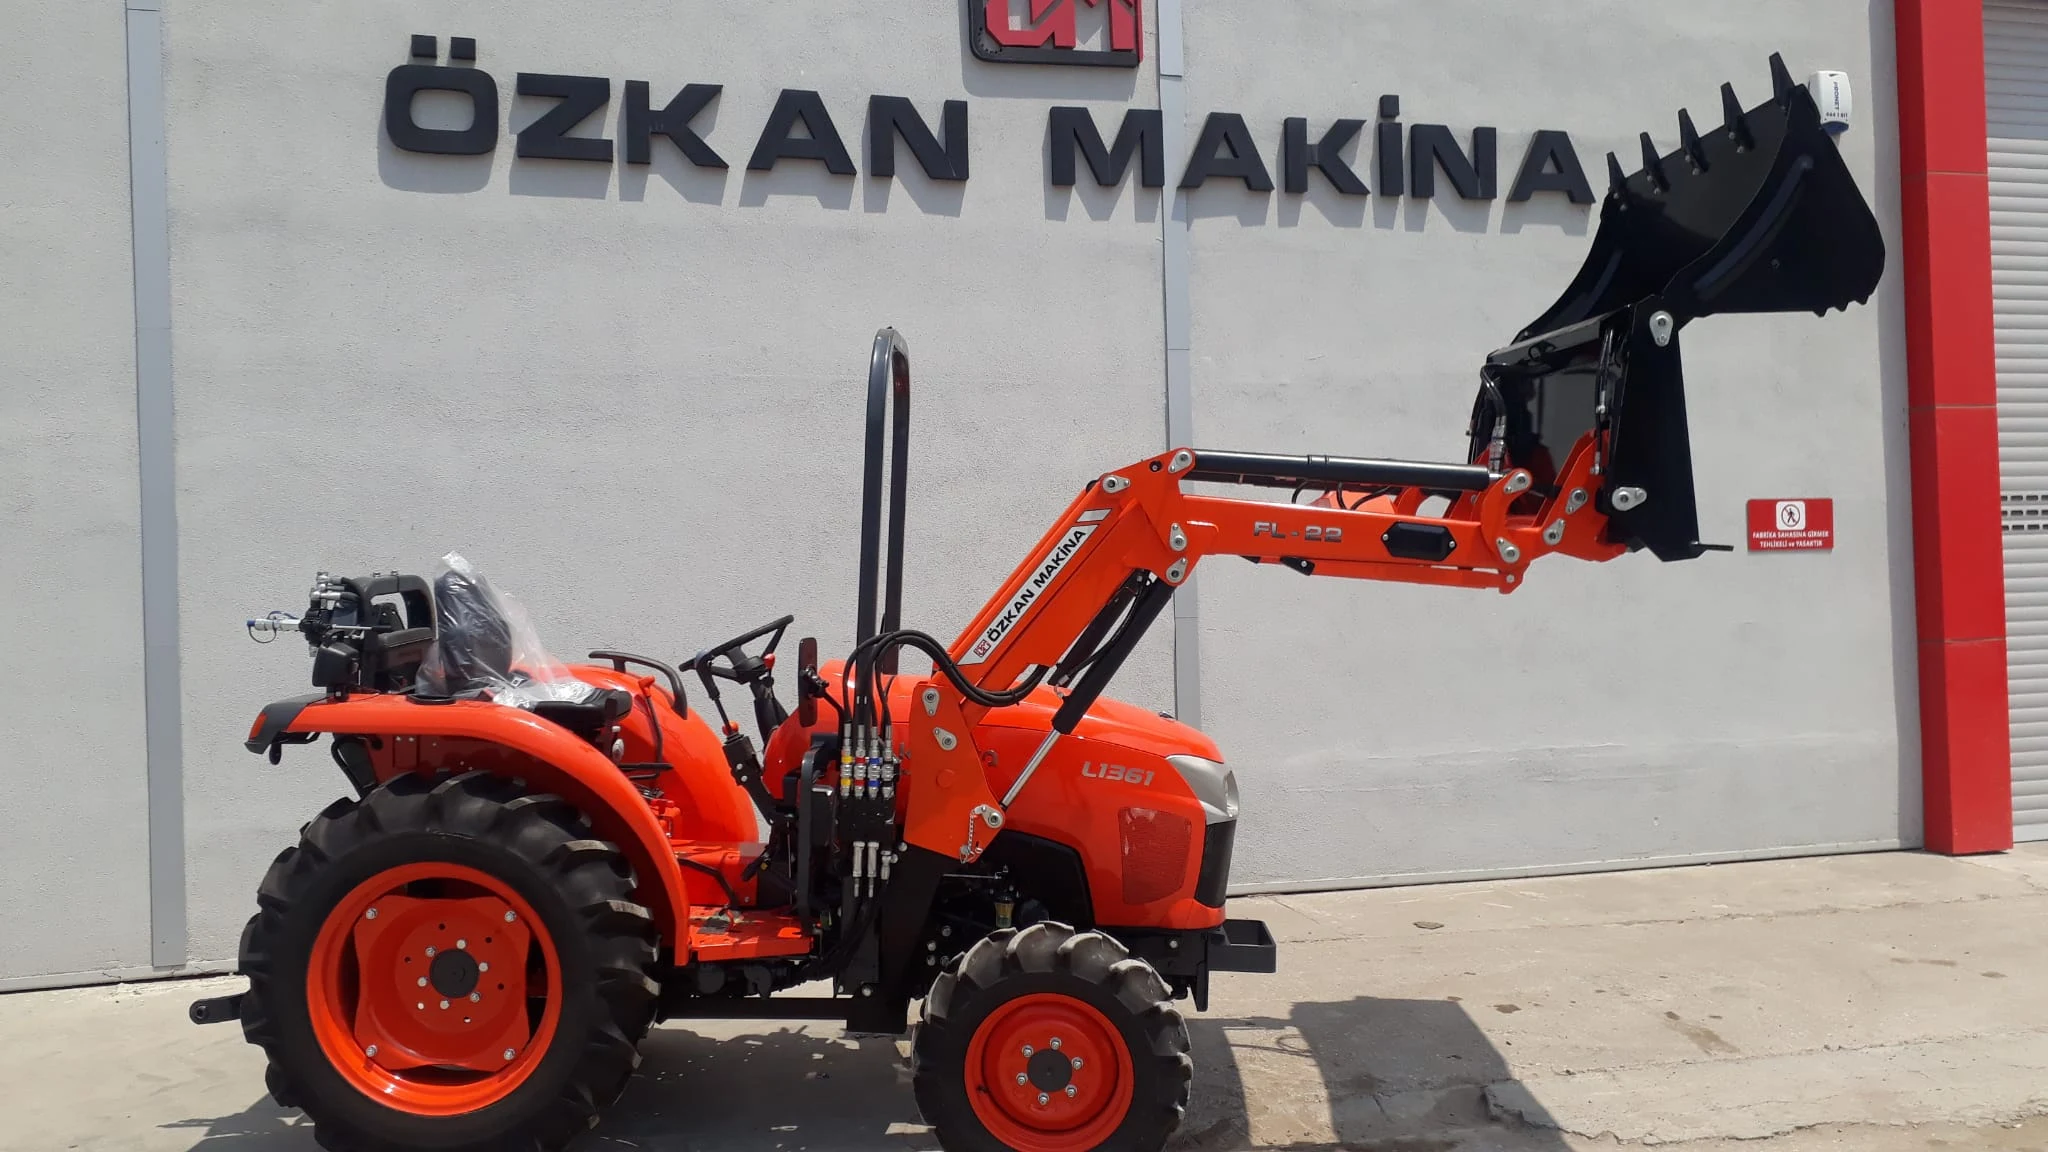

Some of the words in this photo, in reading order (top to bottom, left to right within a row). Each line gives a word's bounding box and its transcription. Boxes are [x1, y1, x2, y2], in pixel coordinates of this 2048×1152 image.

[385, 34, 969, 181] ÖZKAN
[1049, 94, 1597, 204] MAKİNA
[986, 589, 1035, 642] ÖZKAN
[1033, 530, 1087, 589] MAKİNA
[1081, 761, 1155, 786] L1361
